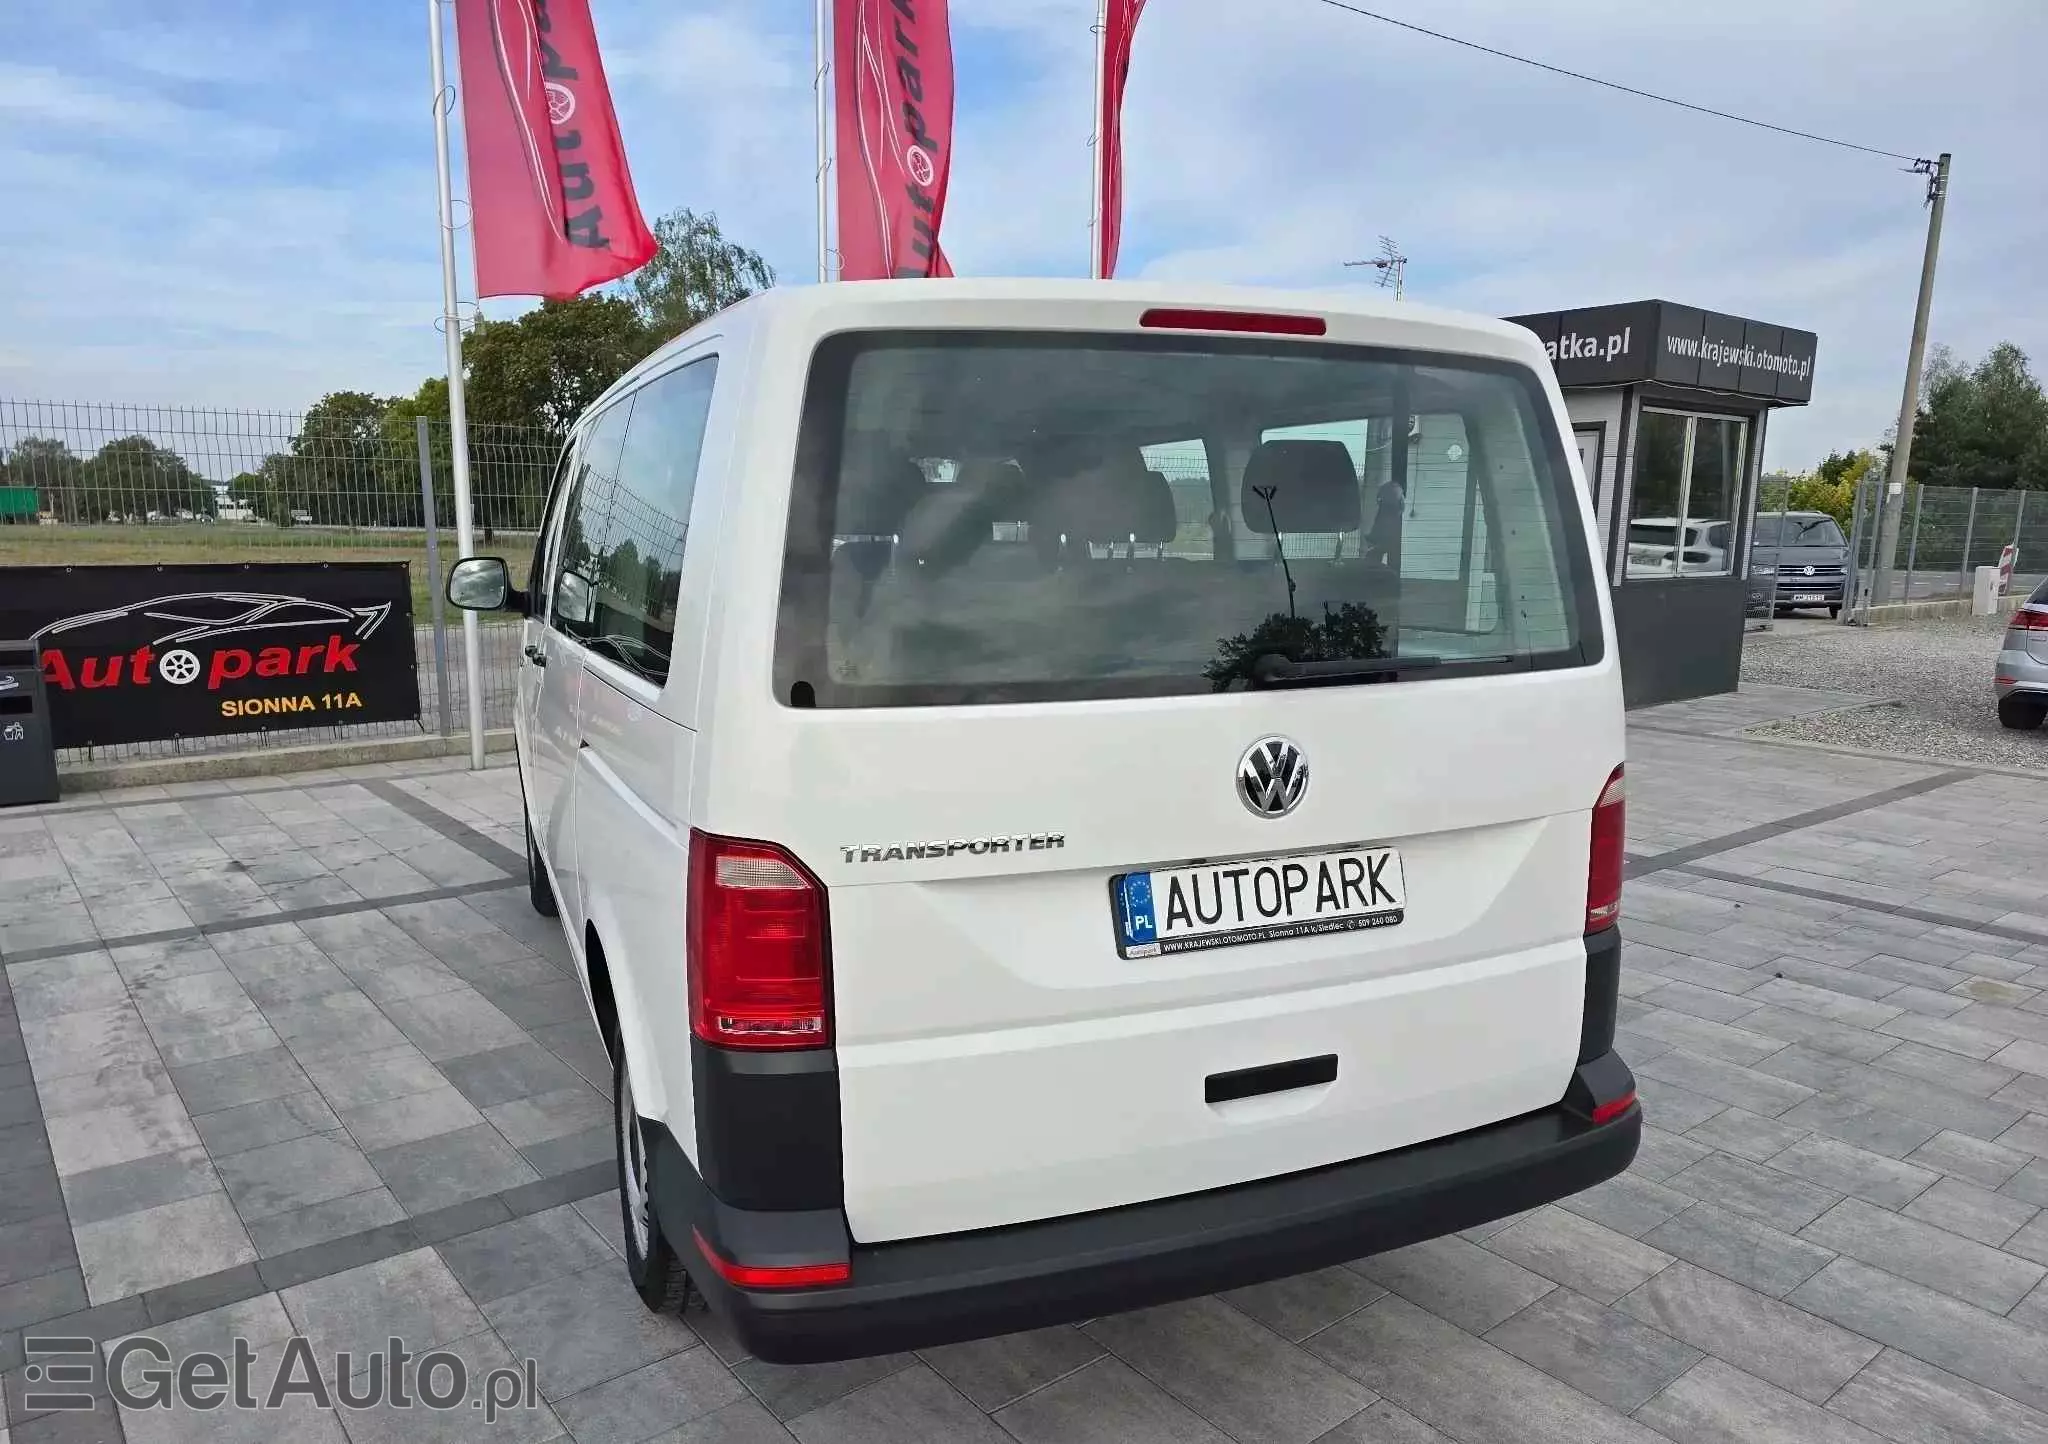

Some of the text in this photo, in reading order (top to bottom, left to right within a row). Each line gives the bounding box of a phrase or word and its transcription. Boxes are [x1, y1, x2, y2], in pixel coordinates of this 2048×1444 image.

[1543, 326, 1632, 362] atka.pl
[1666, 334, 1811, 381] www.krajewski.otomoto.pl
[221, 691, 363, 718] SIONNA 11A
[840, 831, 1066, 864] TRANSPORTER
[1166, 853, 1398, 931] AUTOPARK
[1135, 914, 1153, 931] PL
